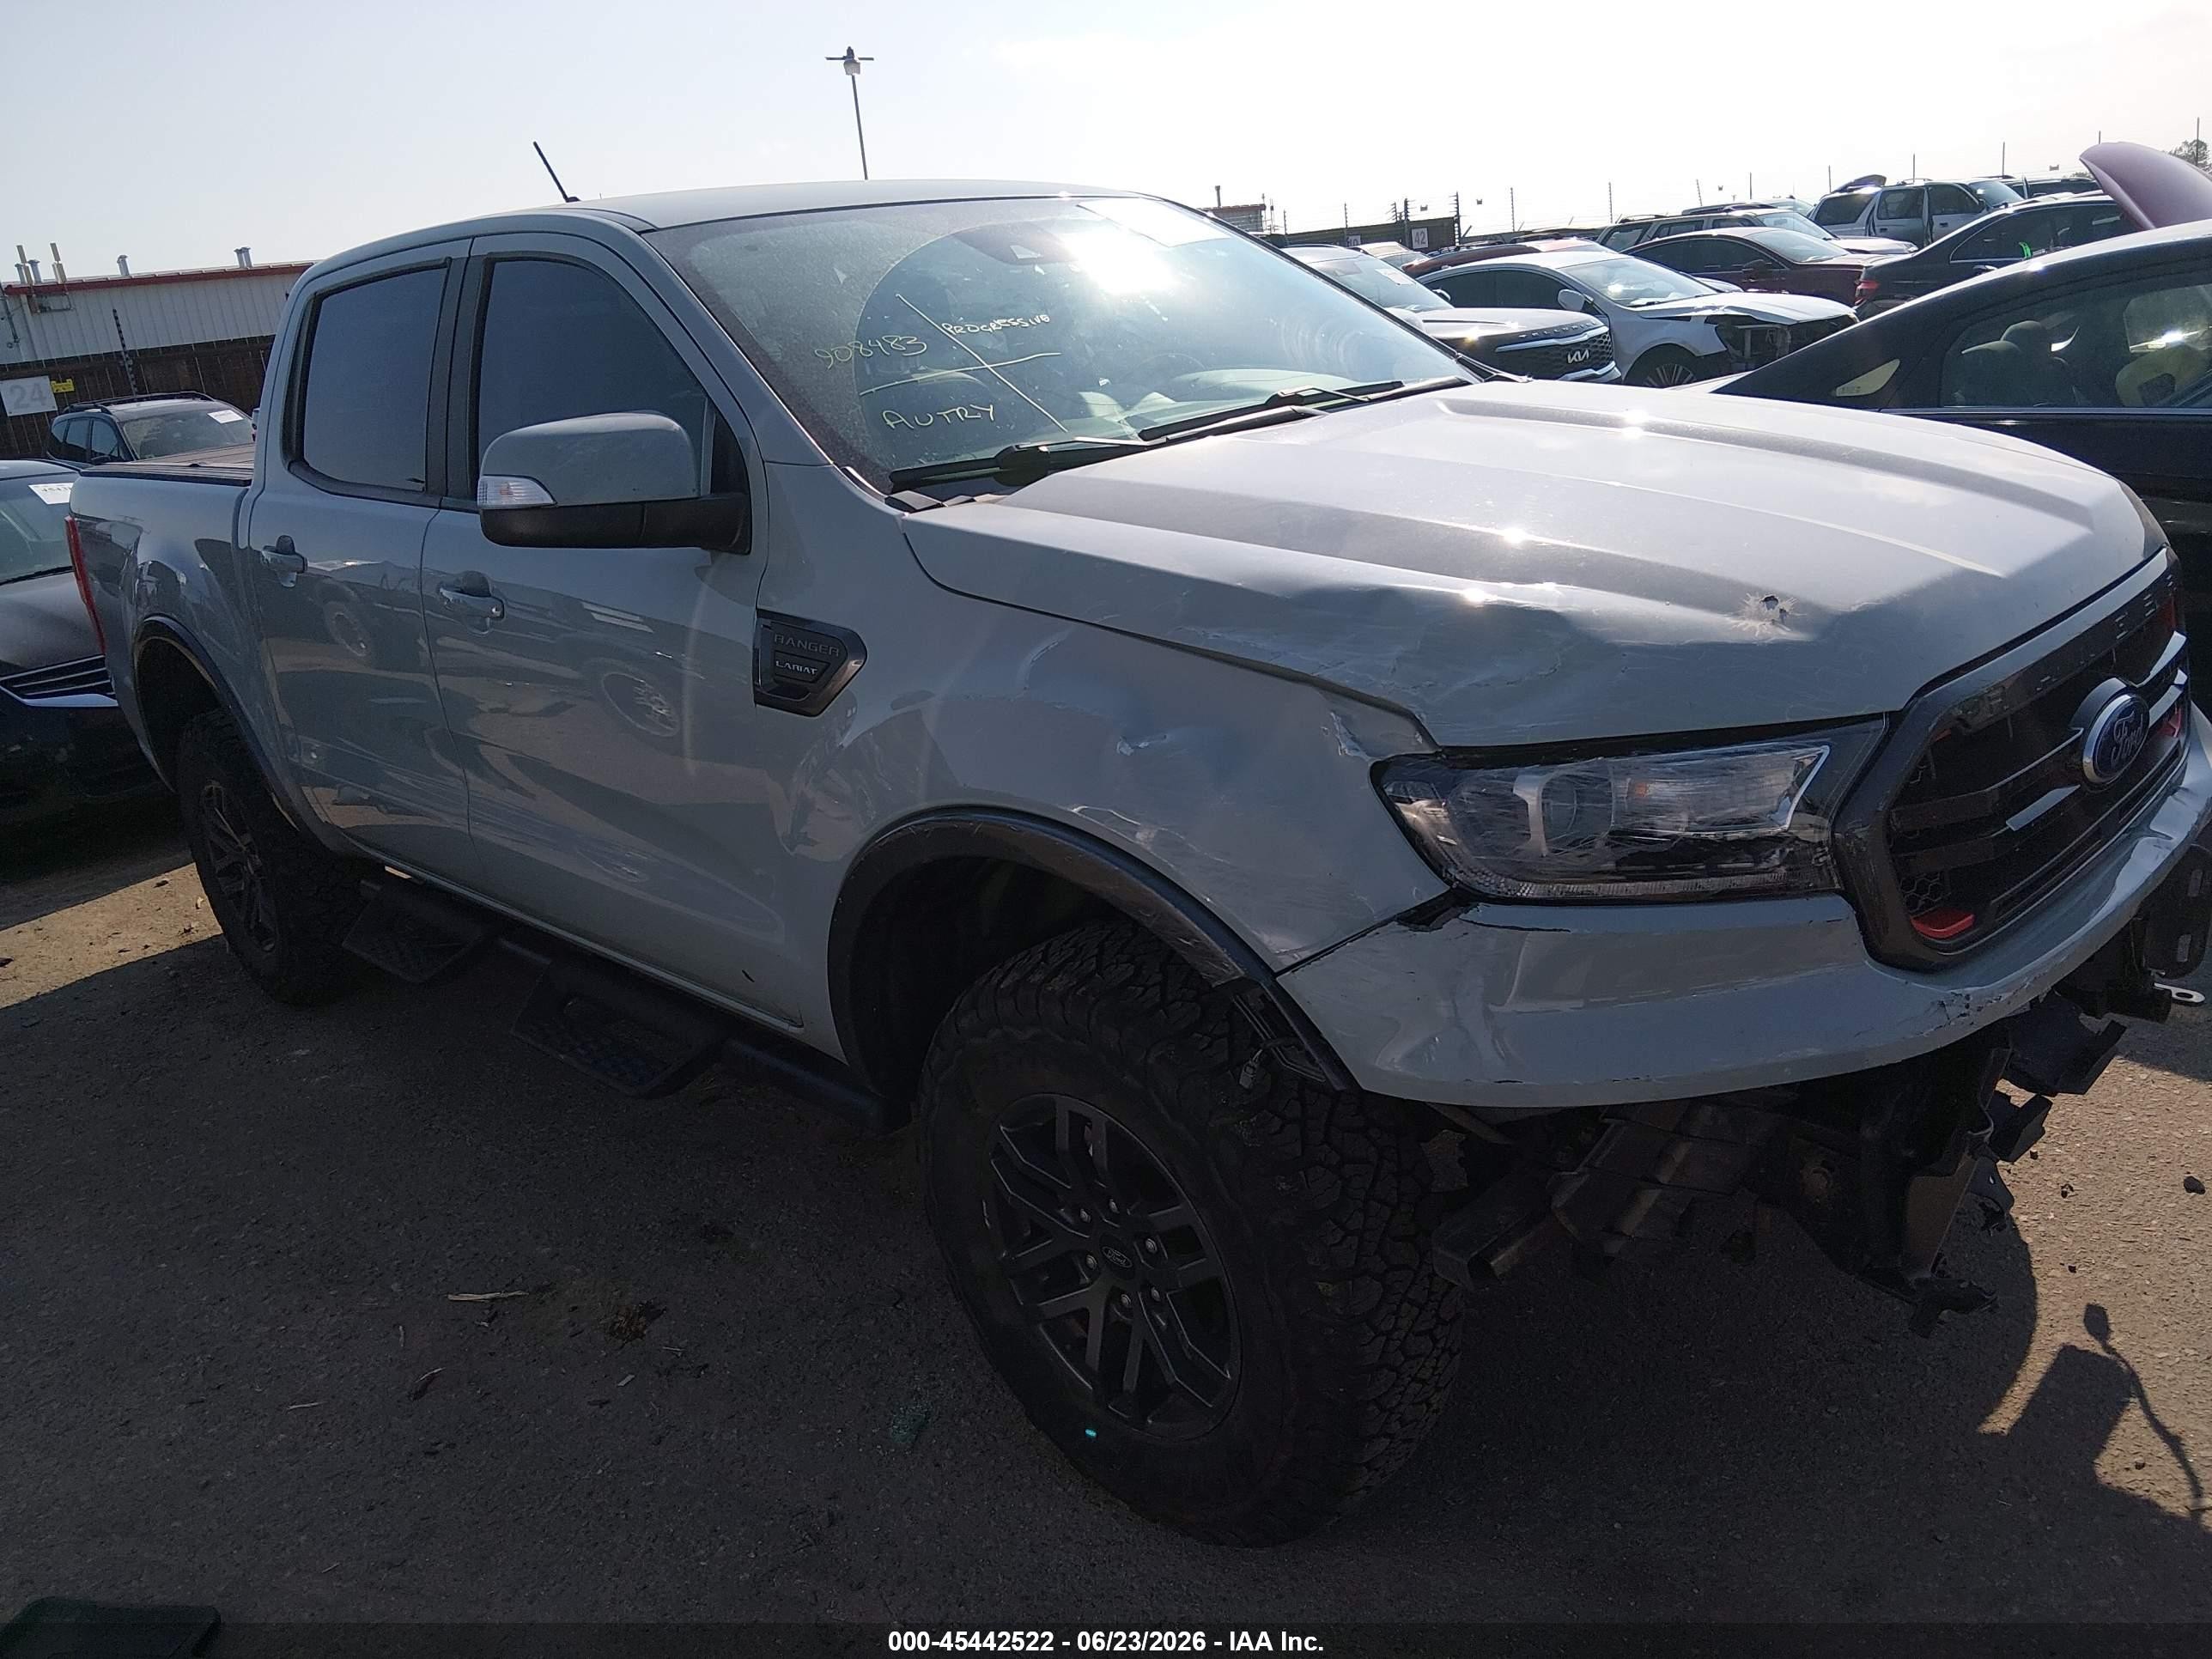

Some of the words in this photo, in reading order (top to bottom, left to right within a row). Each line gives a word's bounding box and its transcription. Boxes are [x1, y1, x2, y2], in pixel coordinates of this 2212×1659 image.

[1414, 230, 1425, 245] 42
[814, 335, 927, 370] 908483
[9, 383, 48, 410] 24
[882, 404, 994, 429] AUTRY
[775, 633, 839, 657] RANGER
[775, 660, 818, 675] LARIAT
[2111, 708, 2145, 768] Ford
